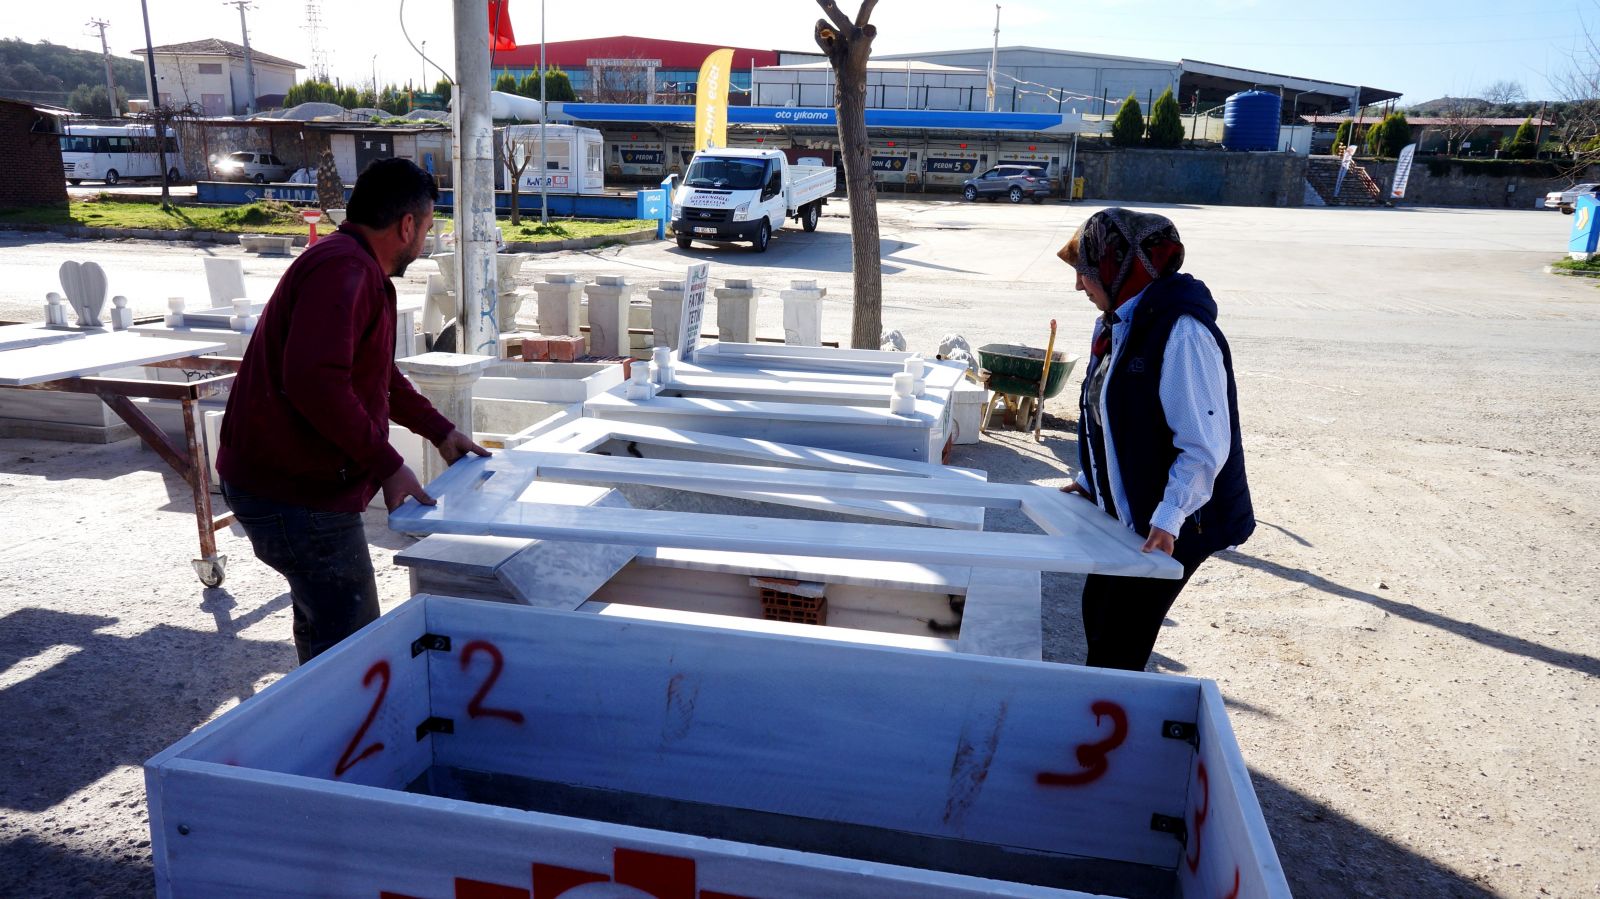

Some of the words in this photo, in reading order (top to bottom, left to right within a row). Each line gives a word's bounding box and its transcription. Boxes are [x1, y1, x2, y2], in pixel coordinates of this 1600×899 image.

[775, 111, 792, 119] oto
[635, 153, 654, 161] PERON
[885, 159, 892, 169] 4
[933, 162, 953, 170] PERON
[954, 162, 962, 172] 5
[460, 639, 525, 725] 2
[334, 659, 390, 777] 2
[1035, 699, 1129, 787] 3
